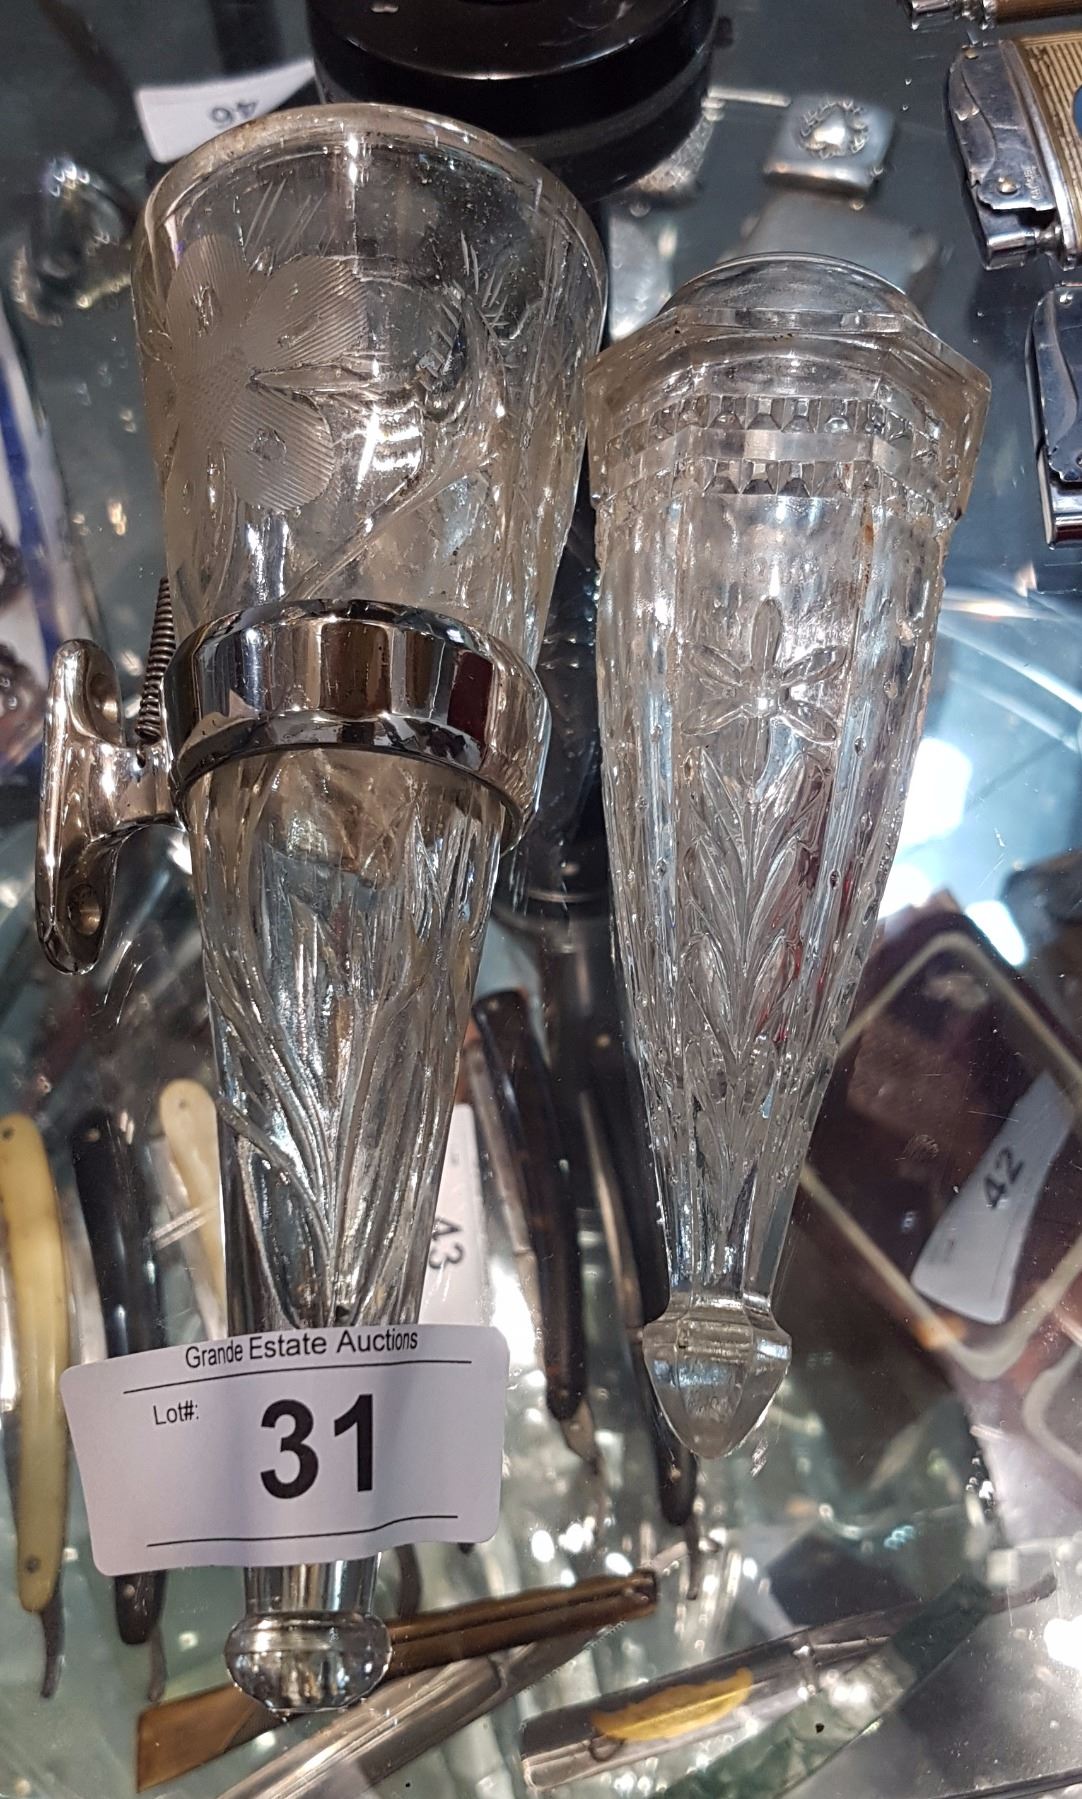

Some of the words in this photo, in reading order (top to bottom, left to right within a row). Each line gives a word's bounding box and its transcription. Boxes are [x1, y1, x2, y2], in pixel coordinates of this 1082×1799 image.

[210, 101, 257, 129] 46
[984, 1149, 1024, 1210] 42
[429, 1217, 465, 1270] 43
[185, 1340, 243, 1369] Grande
[249, 1334, 328, 1360] Estate
[336, 1328, 418, 1354] Auctions
[153, 1401, 200, 1426] Lot#:
[260, 1393, 373, 1500] 31
